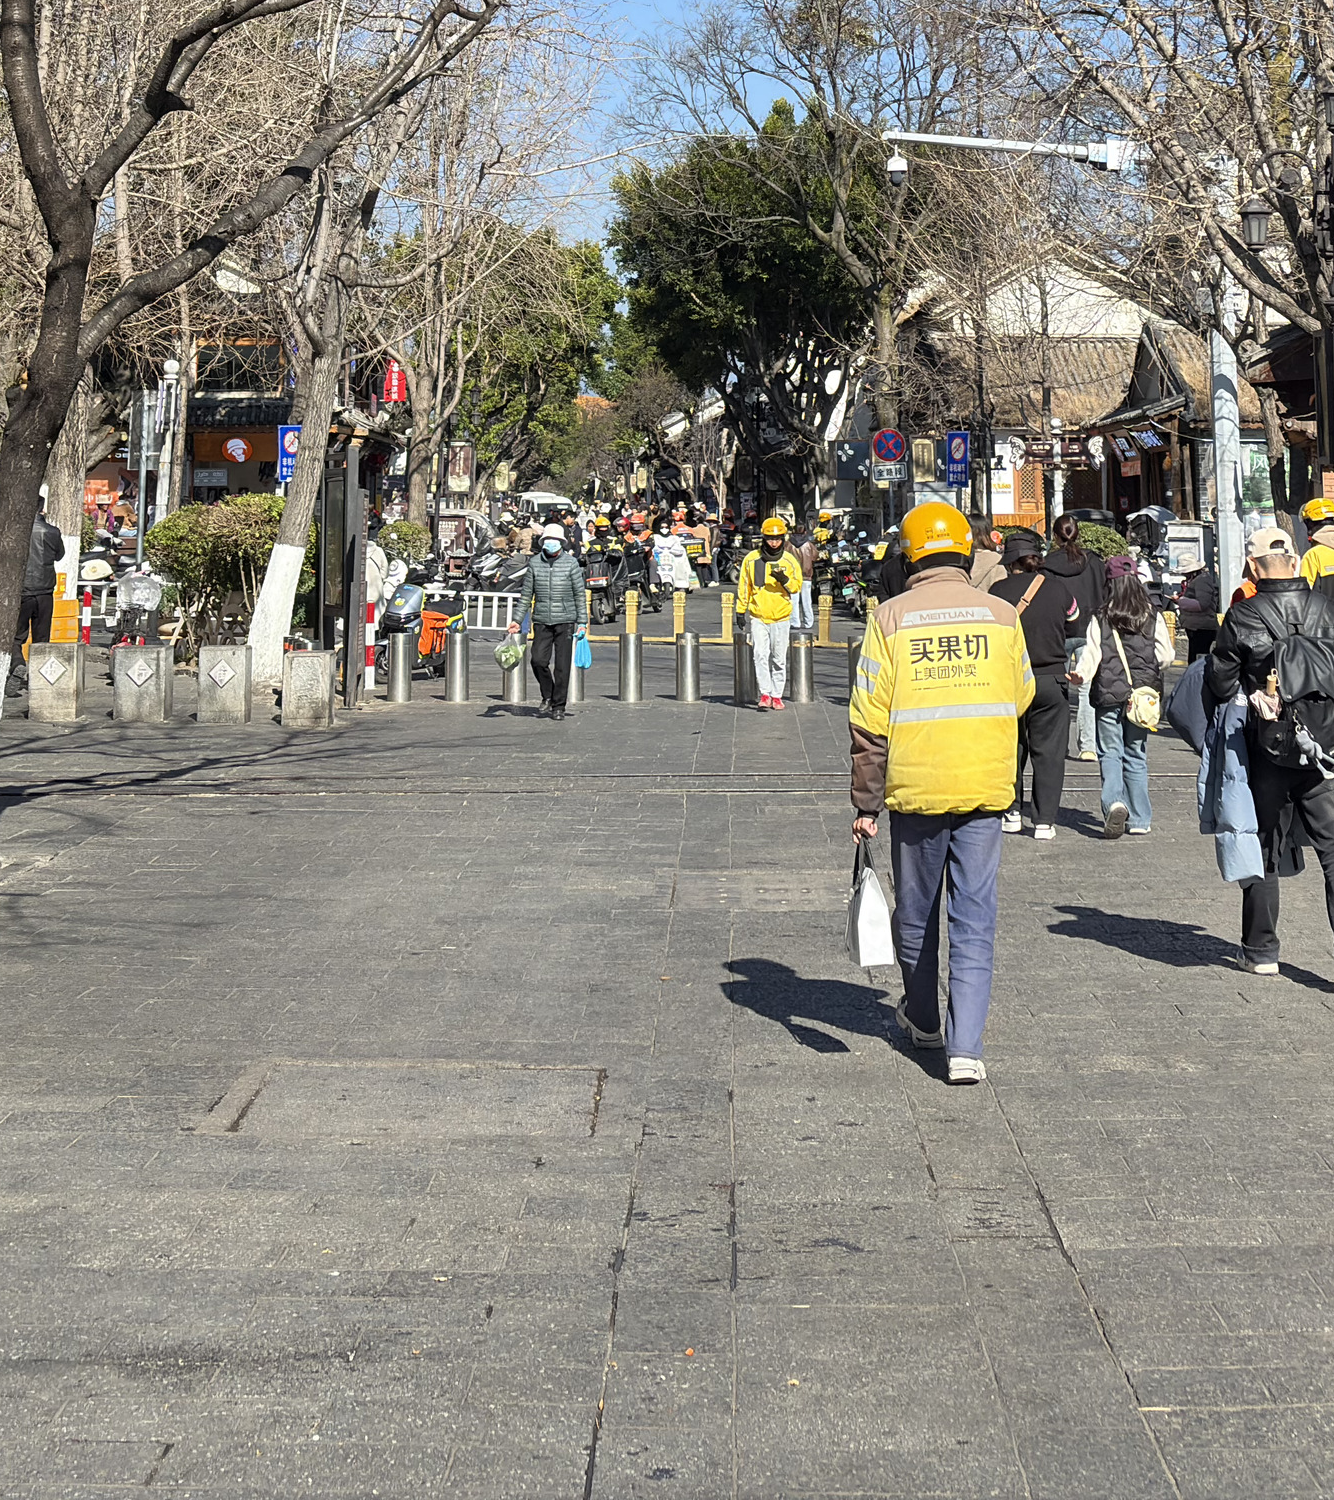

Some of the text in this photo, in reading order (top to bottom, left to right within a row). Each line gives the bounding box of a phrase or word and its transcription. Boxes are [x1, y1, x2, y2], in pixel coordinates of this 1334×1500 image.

[876, 465, 902, 478] 全路段
[919, 610, 975, 621] MEITUAN
[909, 633, 989, 665] 买果切
[910, 663, 977, 682] 上美团外卖
